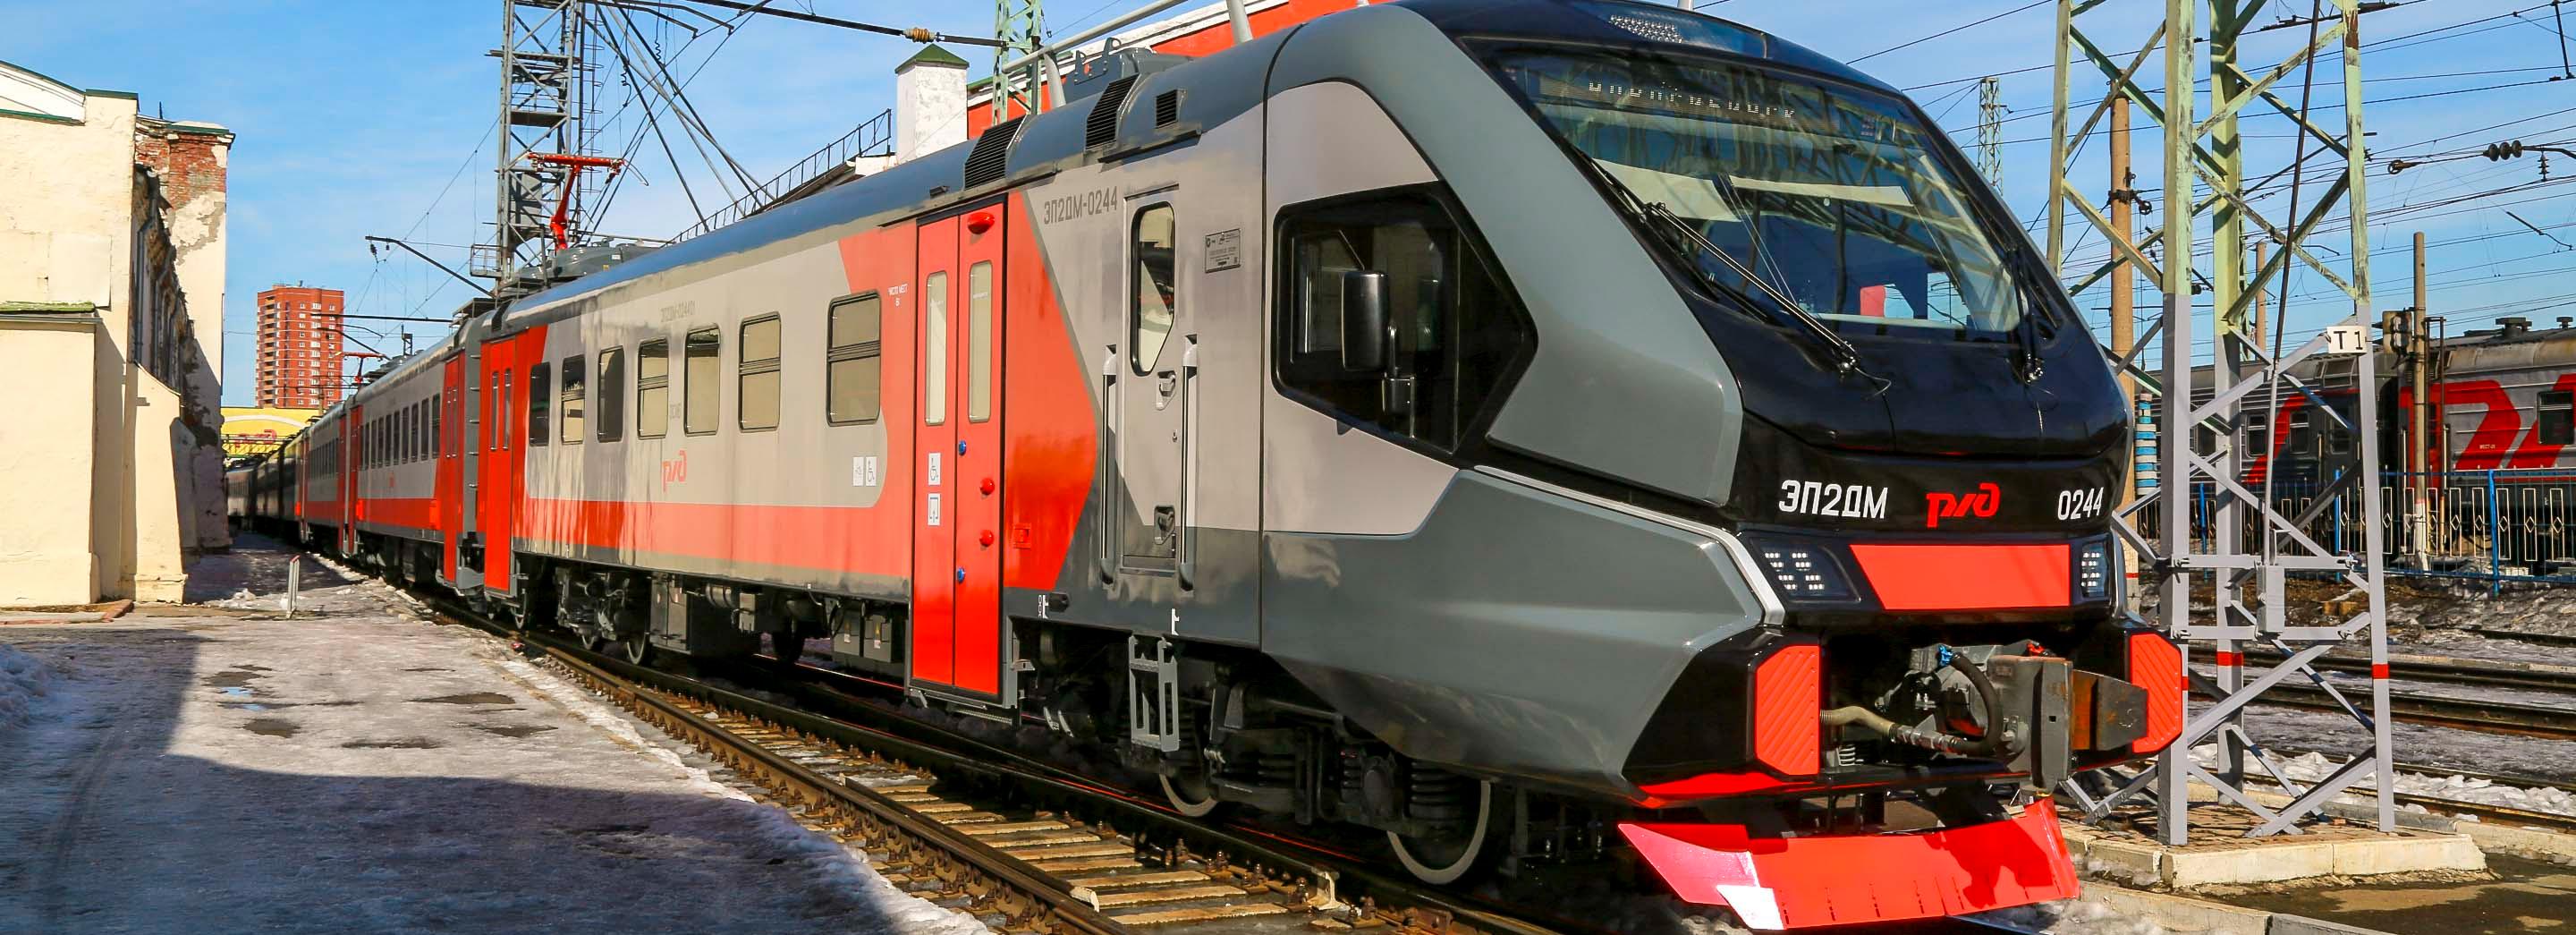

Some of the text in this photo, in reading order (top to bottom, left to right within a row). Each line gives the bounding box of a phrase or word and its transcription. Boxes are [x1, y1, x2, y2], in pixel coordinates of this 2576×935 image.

[1044, 185, 1118, 225] ЭП2ДМ-0244
[1777, 479, 1888, 520] ЭП2ДМ
[2057, 486, 2105, 521] 0244
